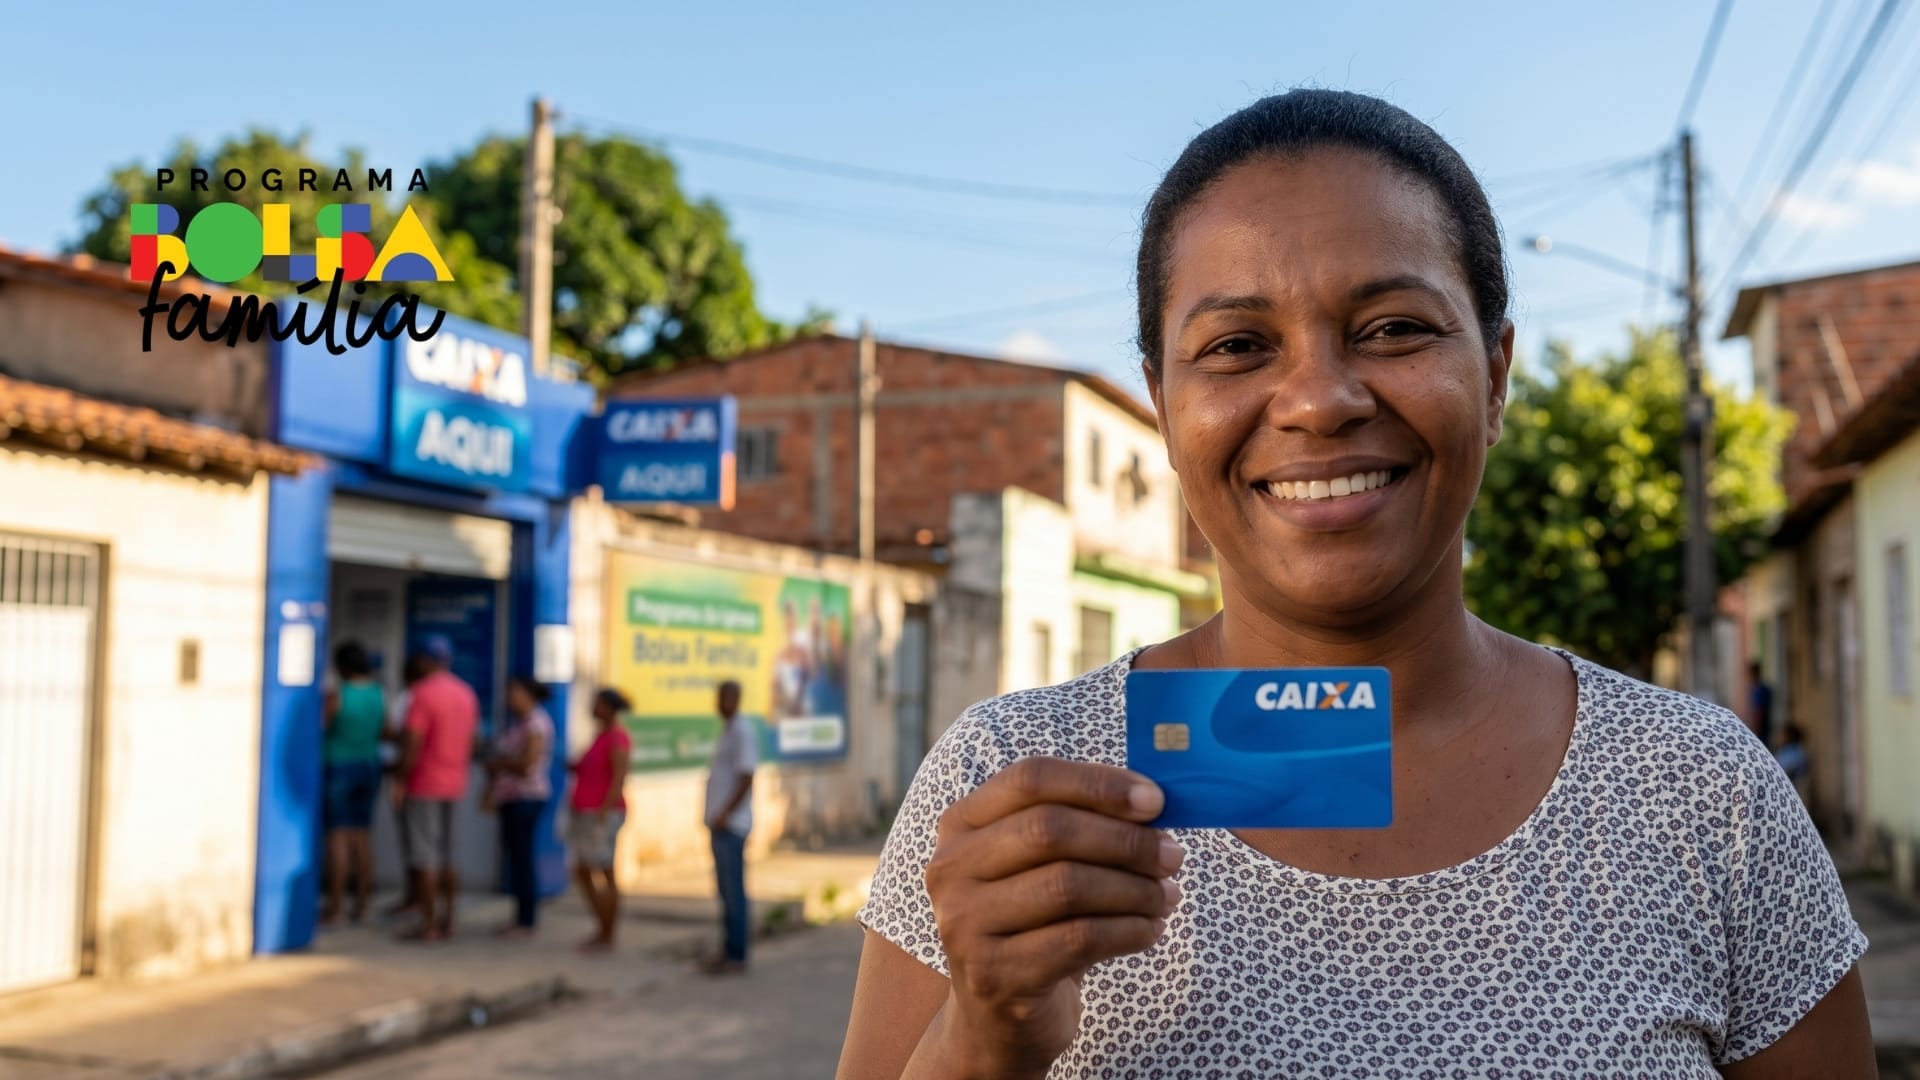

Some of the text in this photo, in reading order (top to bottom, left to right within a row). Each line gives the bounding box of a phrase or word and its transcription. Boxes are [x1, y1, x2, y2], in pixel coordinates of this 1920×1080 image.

[407, 328, 527, 407] CAIXA
[607, 409, 717, 443] CAIXA
[416, 410, 514, 477] AQUI
[619, 463, 706, 496] AQUI
[634, 631, 689, 664] Bolsa
[1255, 682, 1376, 710] CAIXA
